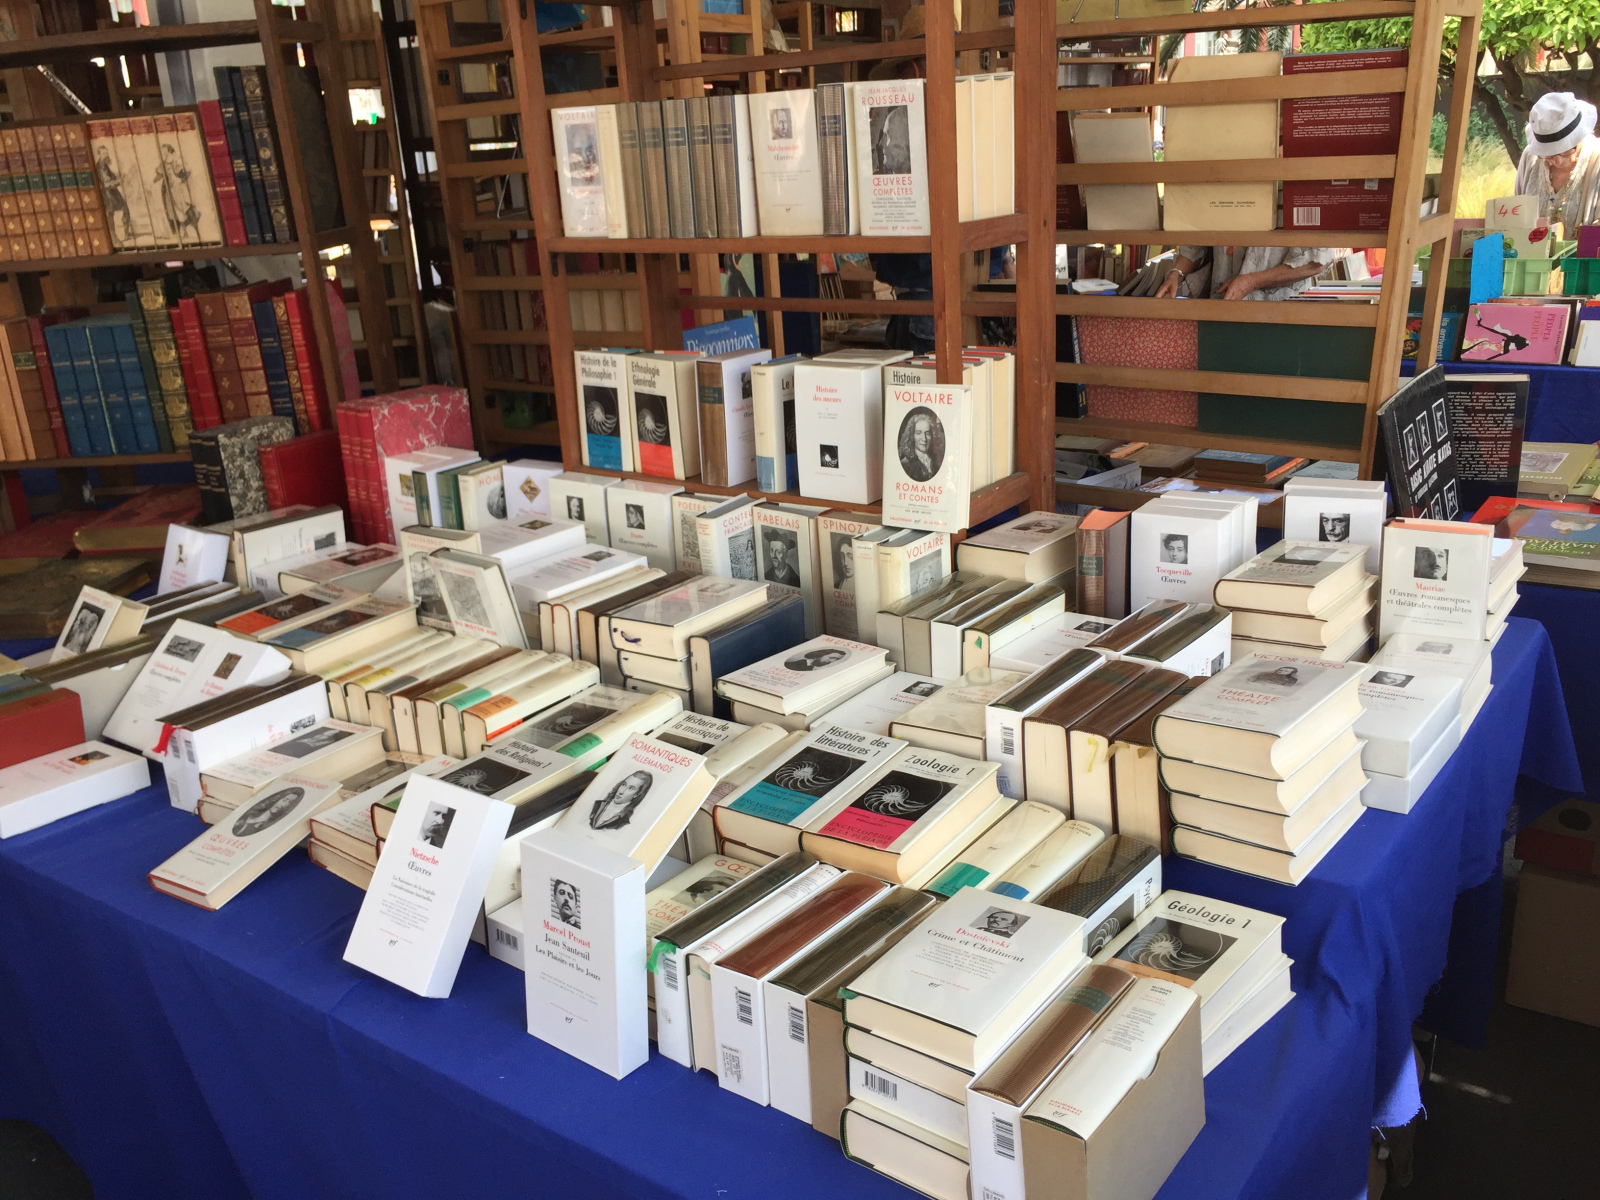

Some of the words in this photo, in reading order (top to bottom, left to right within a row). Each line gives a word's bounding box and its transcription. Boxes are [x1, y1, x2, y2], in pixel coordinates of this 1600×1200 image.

[862, 94, 914, 106] ROUSSEAU
[559, 112, 595, 121] VOLTAIR
[872, 176, 912, 186] ŒUVRES
[873, 188, 914, 196] COMPLÈTES
[580, 355, 601, 366] Histoire
[603, 356, 610, 366] de
[611, 357, 617, 368] la
[582, 367, 612, 380] Philosophie
[632, 362, 660, 377] Ethnologie
[633, 375, 656, 388] Générale
[781, 379, 790, 390] Le
[893, 371, 921, 384] Histoire
[894, 391, 953, 405] VOLTAIRE
[478, 475, 500, 487] HOM
[896, 482, 943, 494] ROMANS
[909, 495, 939, 503] CONTES
[723, 507, 752, 528] CONTEU
[757, 512, 800, 530] RABELAIS
[823, 520, 870, 534] SPINOZA
[907, 535, 943, 559] VOLTAIRE
[1156, 566, 1192, 576] Tocqueville
[1161, 576, 1186, 584] Œuvres
[1416, 582, 1446, 592] Mauriac
[834, 591, 855, 599] ŒUV
[1389, 589, 1418, 599] Œuvres
[1421, 593, 1470, 604] romanesques
[835, 600, 857, 609] COMPL
[1396, 598, 1432, 610] théâtrales
[1434, 604, 1472, 613] complètes
[1253, 652, 1298, 664] VICTOR
[1302, 659, 1345, 670] HUGO
[1217, 694, 1271, 706] COMPLET
[683, 714, 714, 728] Histoire
[716, 722, 730, 732] de
[672, 722, 680, 730] la
[681, 725, 720, 741] musique
[826, 726, 866, 743] Histoire
[869, 735, 890, 749] des
[508, 741, 538, 754] Histoire
[815, 734, 870, 755] littératures
[496, 748, 508, 757] des
[509, 750, 544, 769] Religions
[630, 739, 693, 768] ROMANTIQUES
[632, 754, 674, 774] ALLEMANDS
[904, 755, 961, 775] Zoologie
[741, 797, 797, 817] ENCYCLOPÉDIE
[830, 822, 893, 840] ENCYCLOPÉDIE
[850, 832, 888, 845] PLÉIADE
[210, 834, 250, 850] ŒUVRES
[410, 847, 439, 866] Nietzsche
[408, 861, 432, 877] Œuvres
[714, 859, 756, 876] GŒT
[655, 900, 687, 916] THÉA
[1167, 901, 1235, 925] Géologie
[543, 919, 566, 938] Marcel
[568, 931, 591, 949] Proust
[545, 933, 560, 948] Jean
[562, 941, 590, 961] Santeuil
[927, 929, 956, 941] Crime
[973, 942, 1024, 962] Châtiment
[536, 945, 546, 954] Les
[547, 950, 567, 965] Plaisirs
[576, 964, 584, 973] les
[586, 968, 601, 981] Jours
